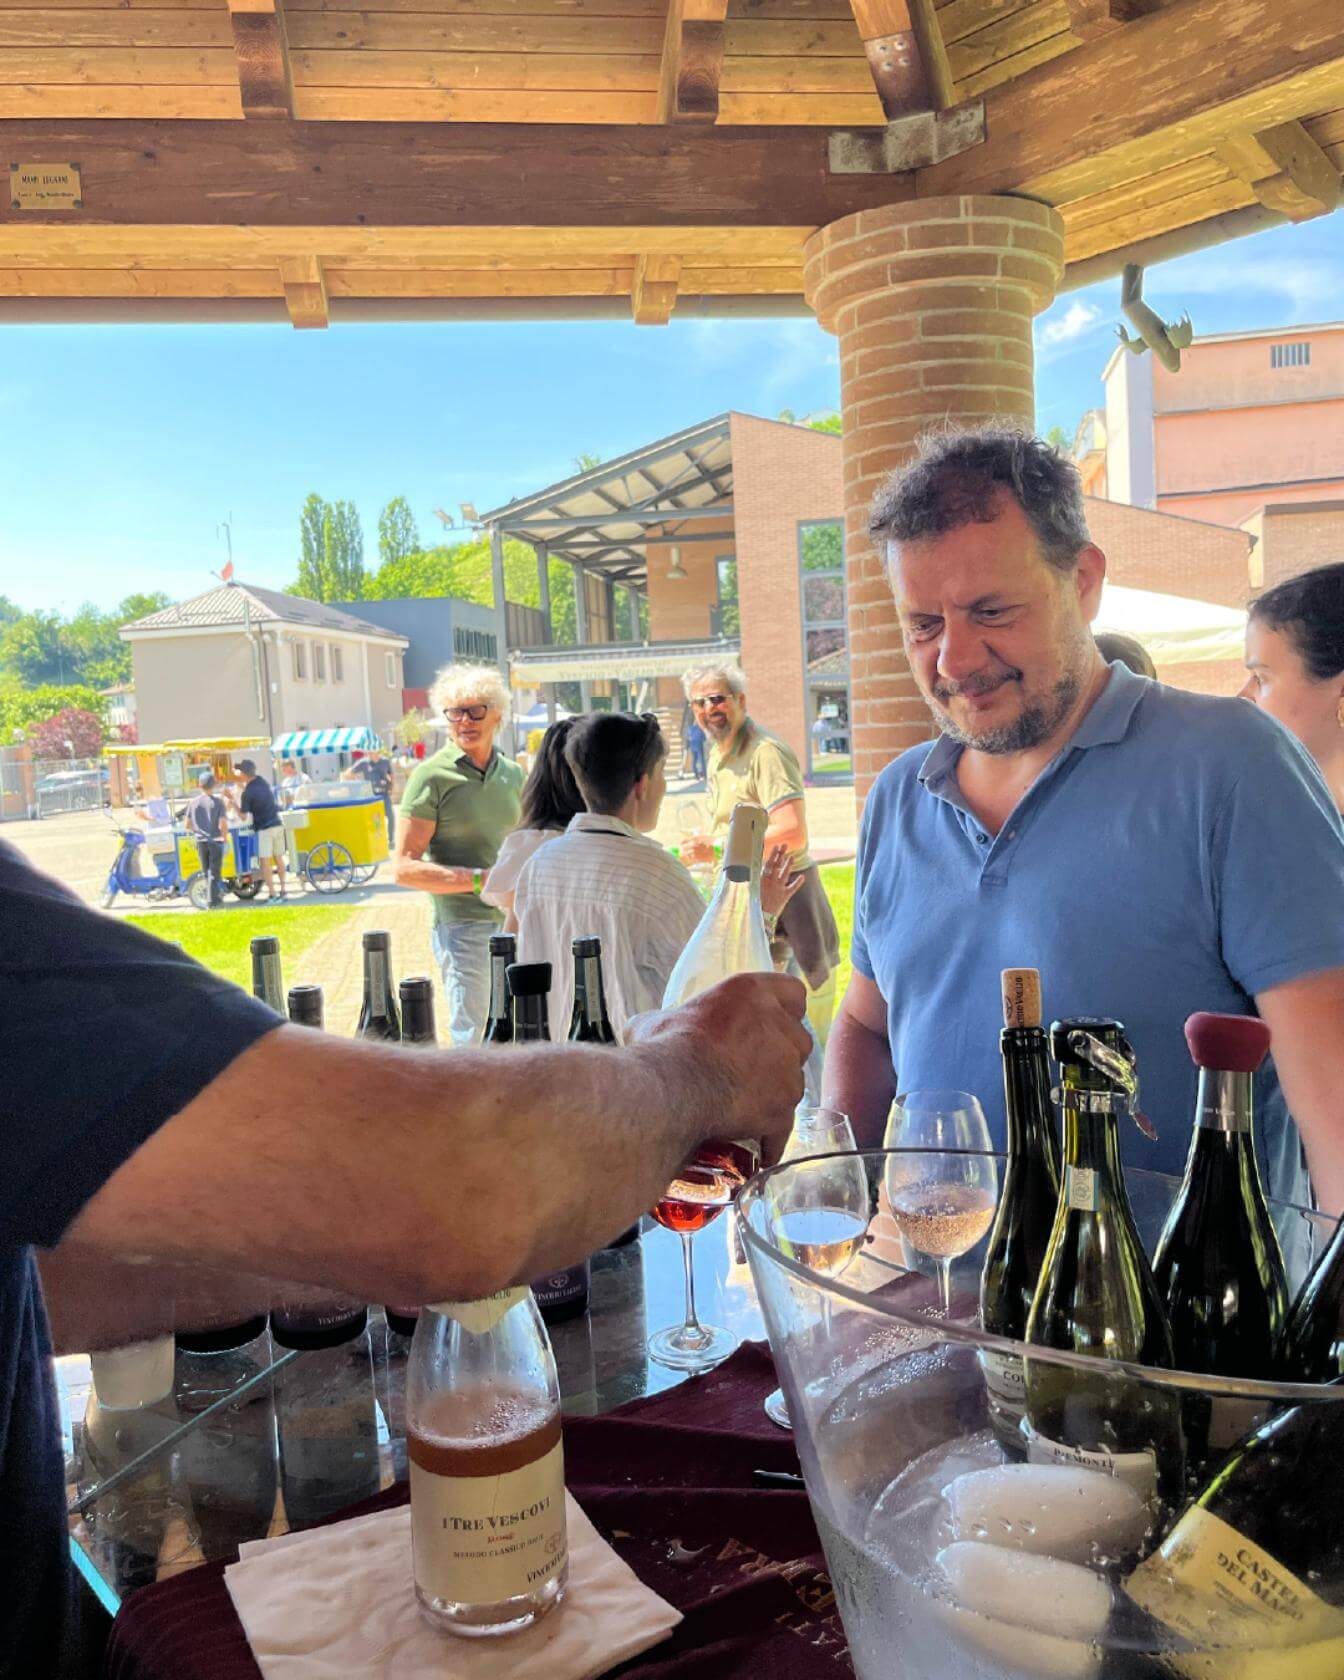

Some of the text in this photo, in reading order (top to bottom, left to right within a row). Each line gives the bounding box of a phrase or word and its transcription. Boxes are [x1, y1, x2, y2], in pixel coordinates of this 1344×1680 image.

[450, 1516, 484, 1531] TRE
[486, 1497, 551, 1529] VESCOVI
[489, 1542, 526, 1558] CLASSICO
[1216, 1551, 1247, 1586] DEL
[1236, 1548, 1300, 1606] CASTEL
